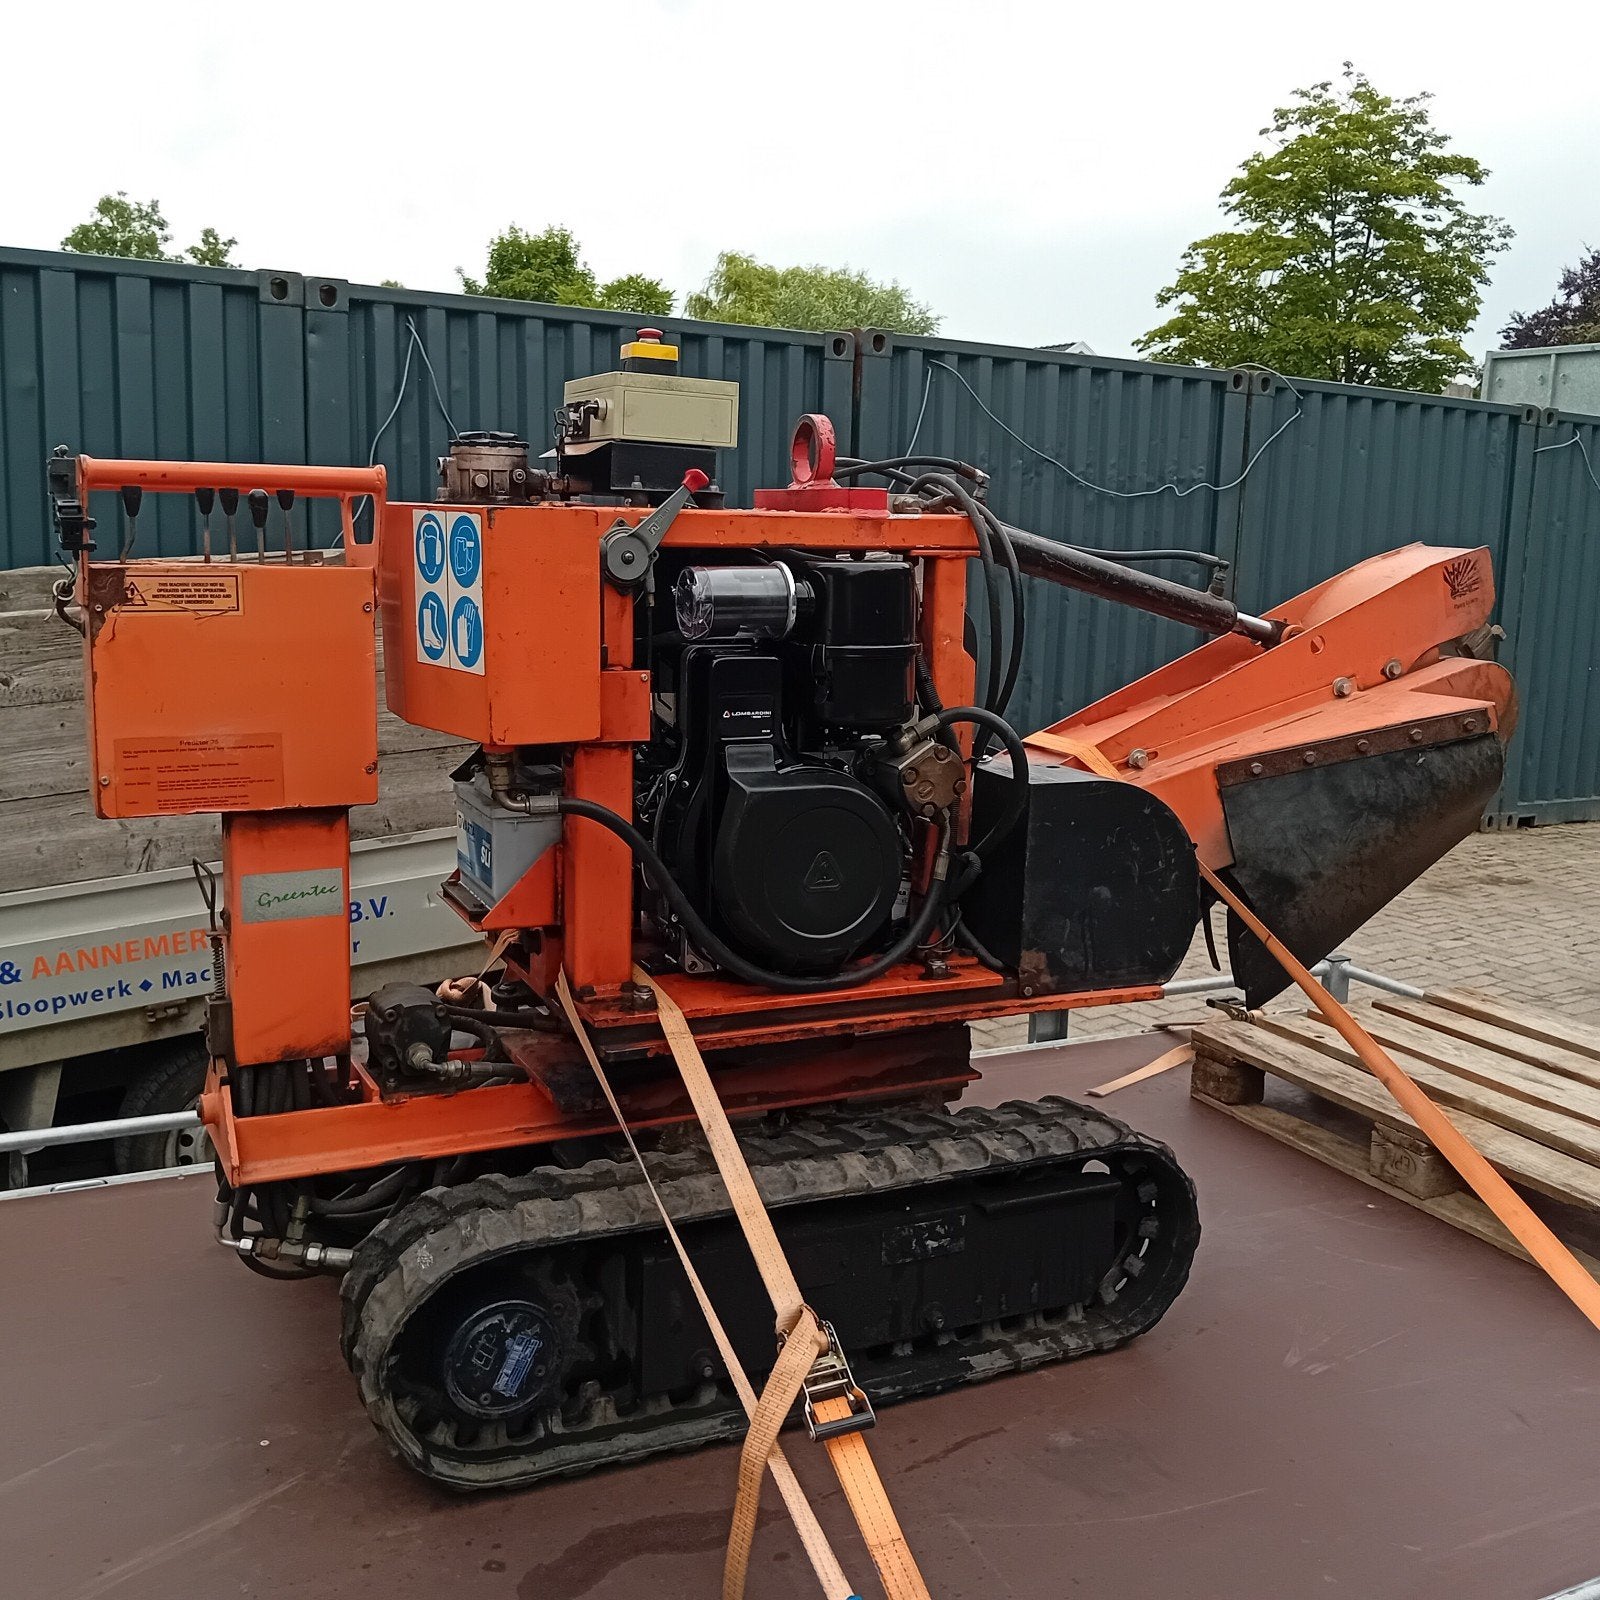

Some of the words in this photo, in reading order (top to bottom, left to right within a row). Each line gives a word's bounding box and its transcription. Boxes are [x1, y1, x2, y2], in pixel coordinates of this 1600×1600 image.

[257, 884, 340, 908] Greentec
[0, 961, 22, 985] &
[31, 928, 209, 979] AANNEMER
[349, 896, 394, 923] B.V.
[162, 968, 211, 990] Mac
